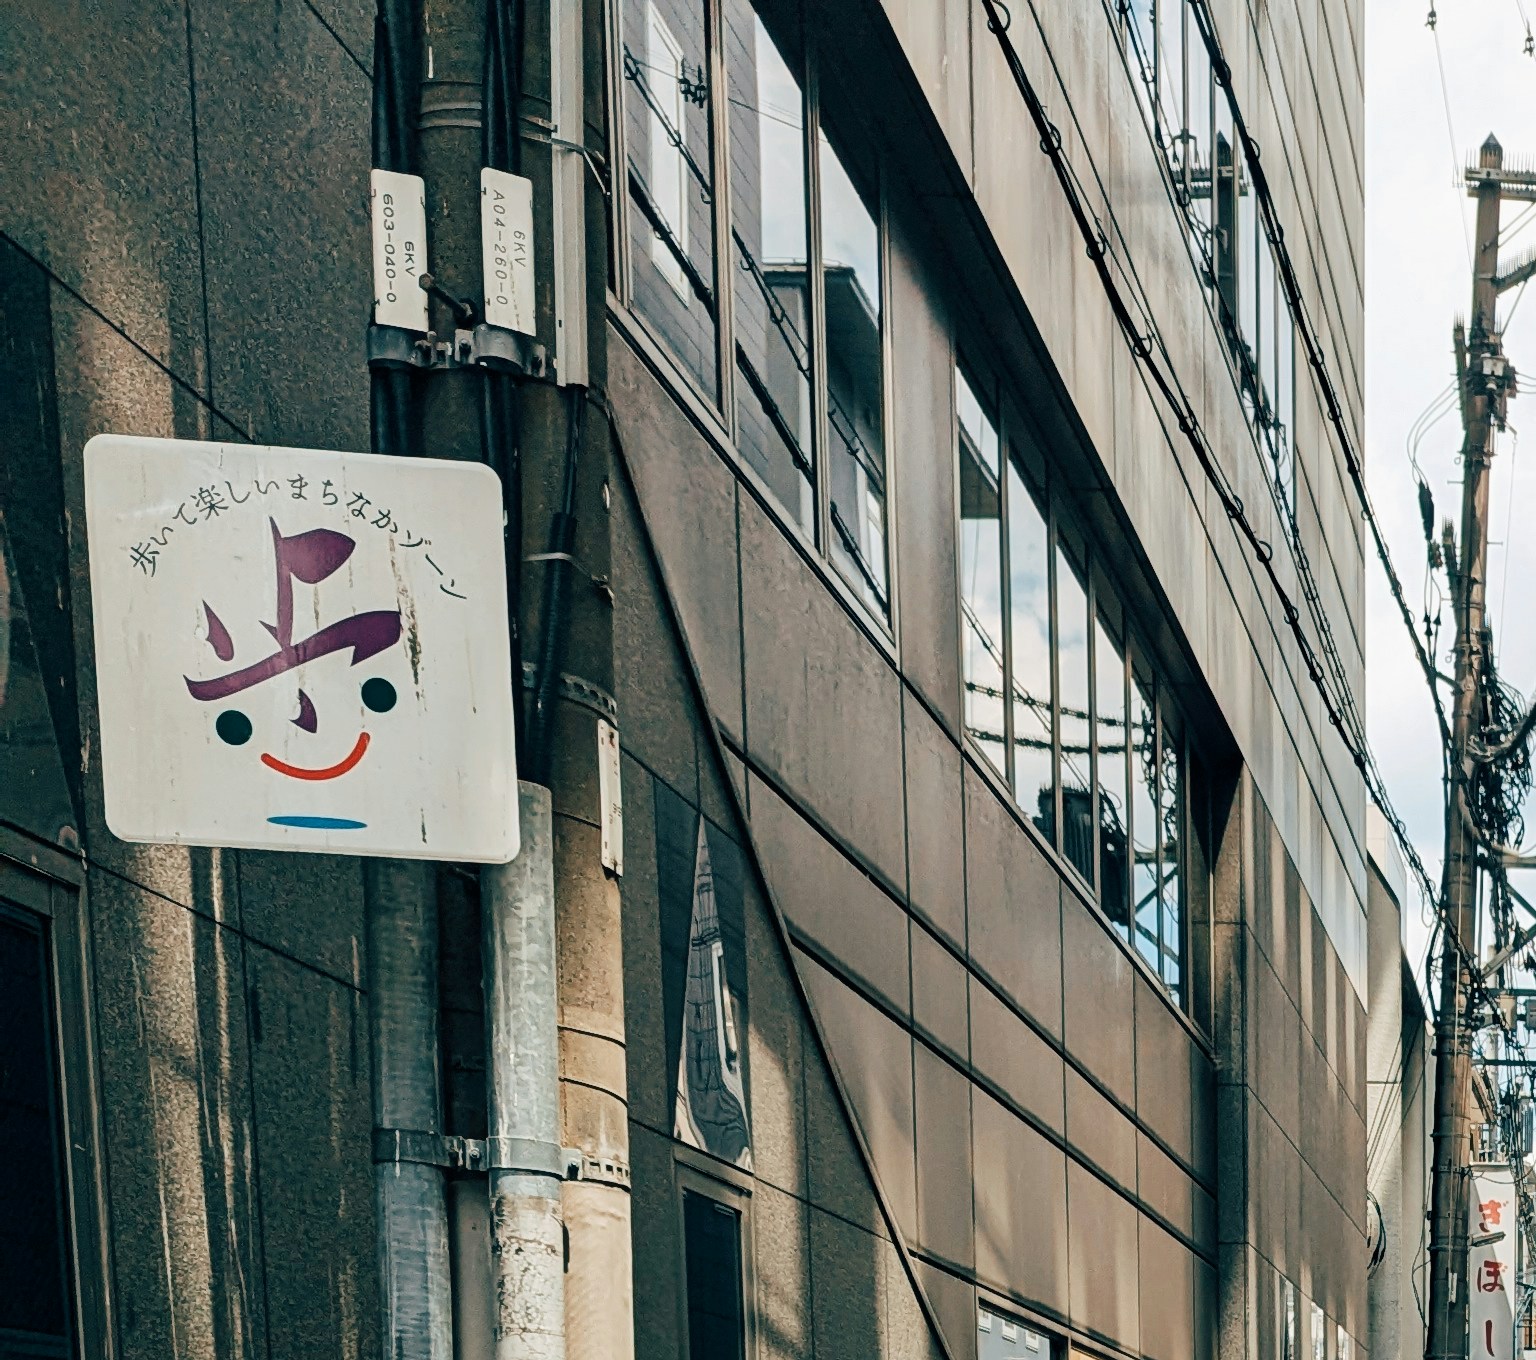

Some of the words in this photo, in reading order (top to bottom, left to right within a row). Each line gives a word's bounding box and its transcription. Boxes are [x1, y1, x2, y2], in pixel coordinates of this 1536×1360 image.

[404, 241, 416, 277] 6KV
[513, 230, 526, 268] 6KV
[129, 473, 467, 600] 歩いて楽しいまちなかゾーン
[1477, 1199, 1509, 1357] ぎぼし
